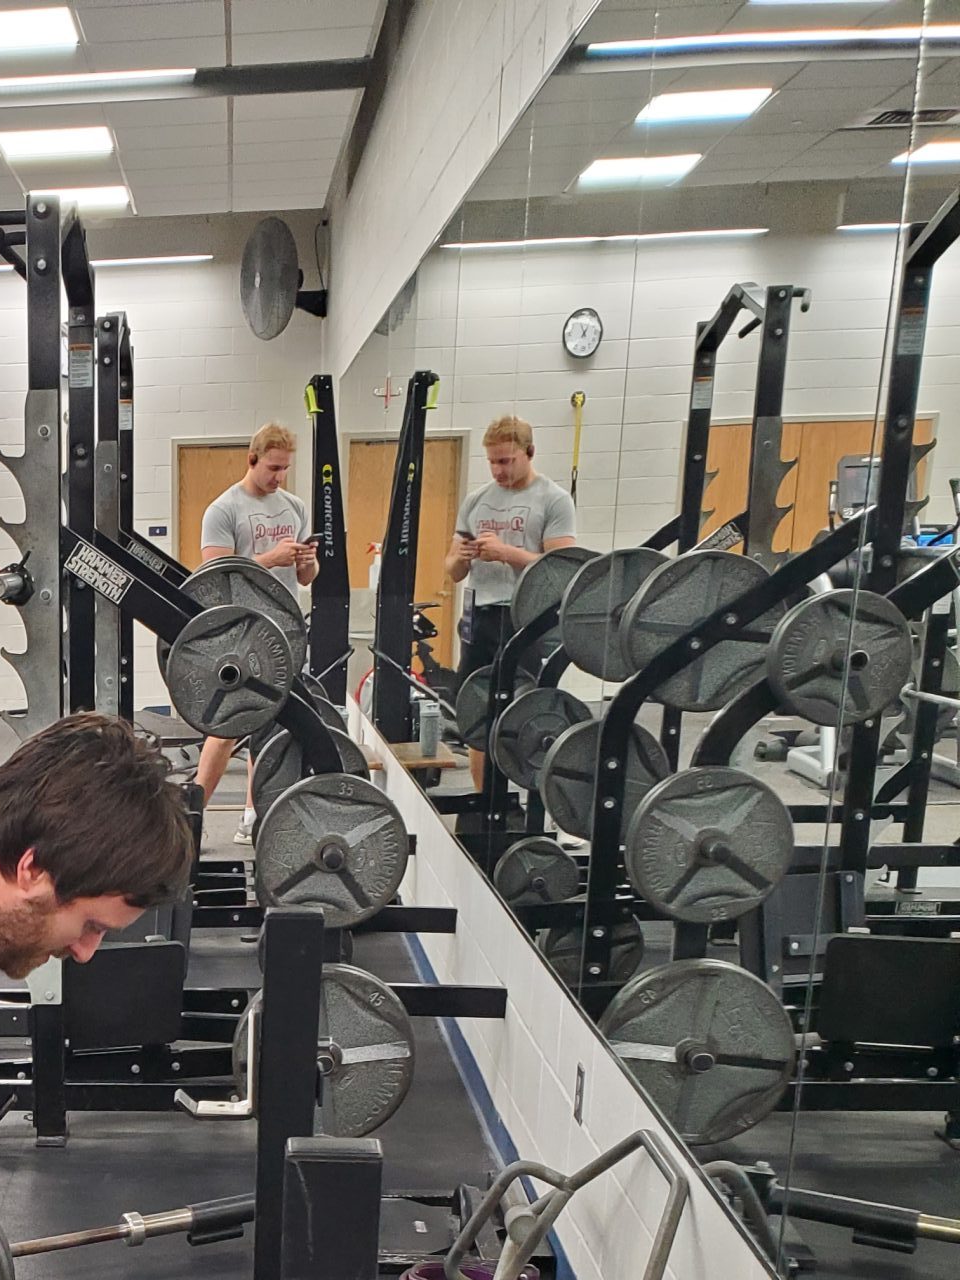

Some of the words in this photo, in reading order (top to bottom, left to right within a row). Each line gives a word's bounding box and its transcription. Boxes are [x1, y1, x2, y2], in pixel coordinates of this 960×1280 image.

[323, 485, 334, 546] concept
[255, 522, 294, 542] Dayton
[76, 545, 127, 588] HAMMER
[324, 549, 335, 558] 2
[68, 556, 123, 601] STRENGTH
[257, 624, 289, 689] HAMPTON
[339, 782, 354, 796] 35
[368, 991, 386, 1007] 45
